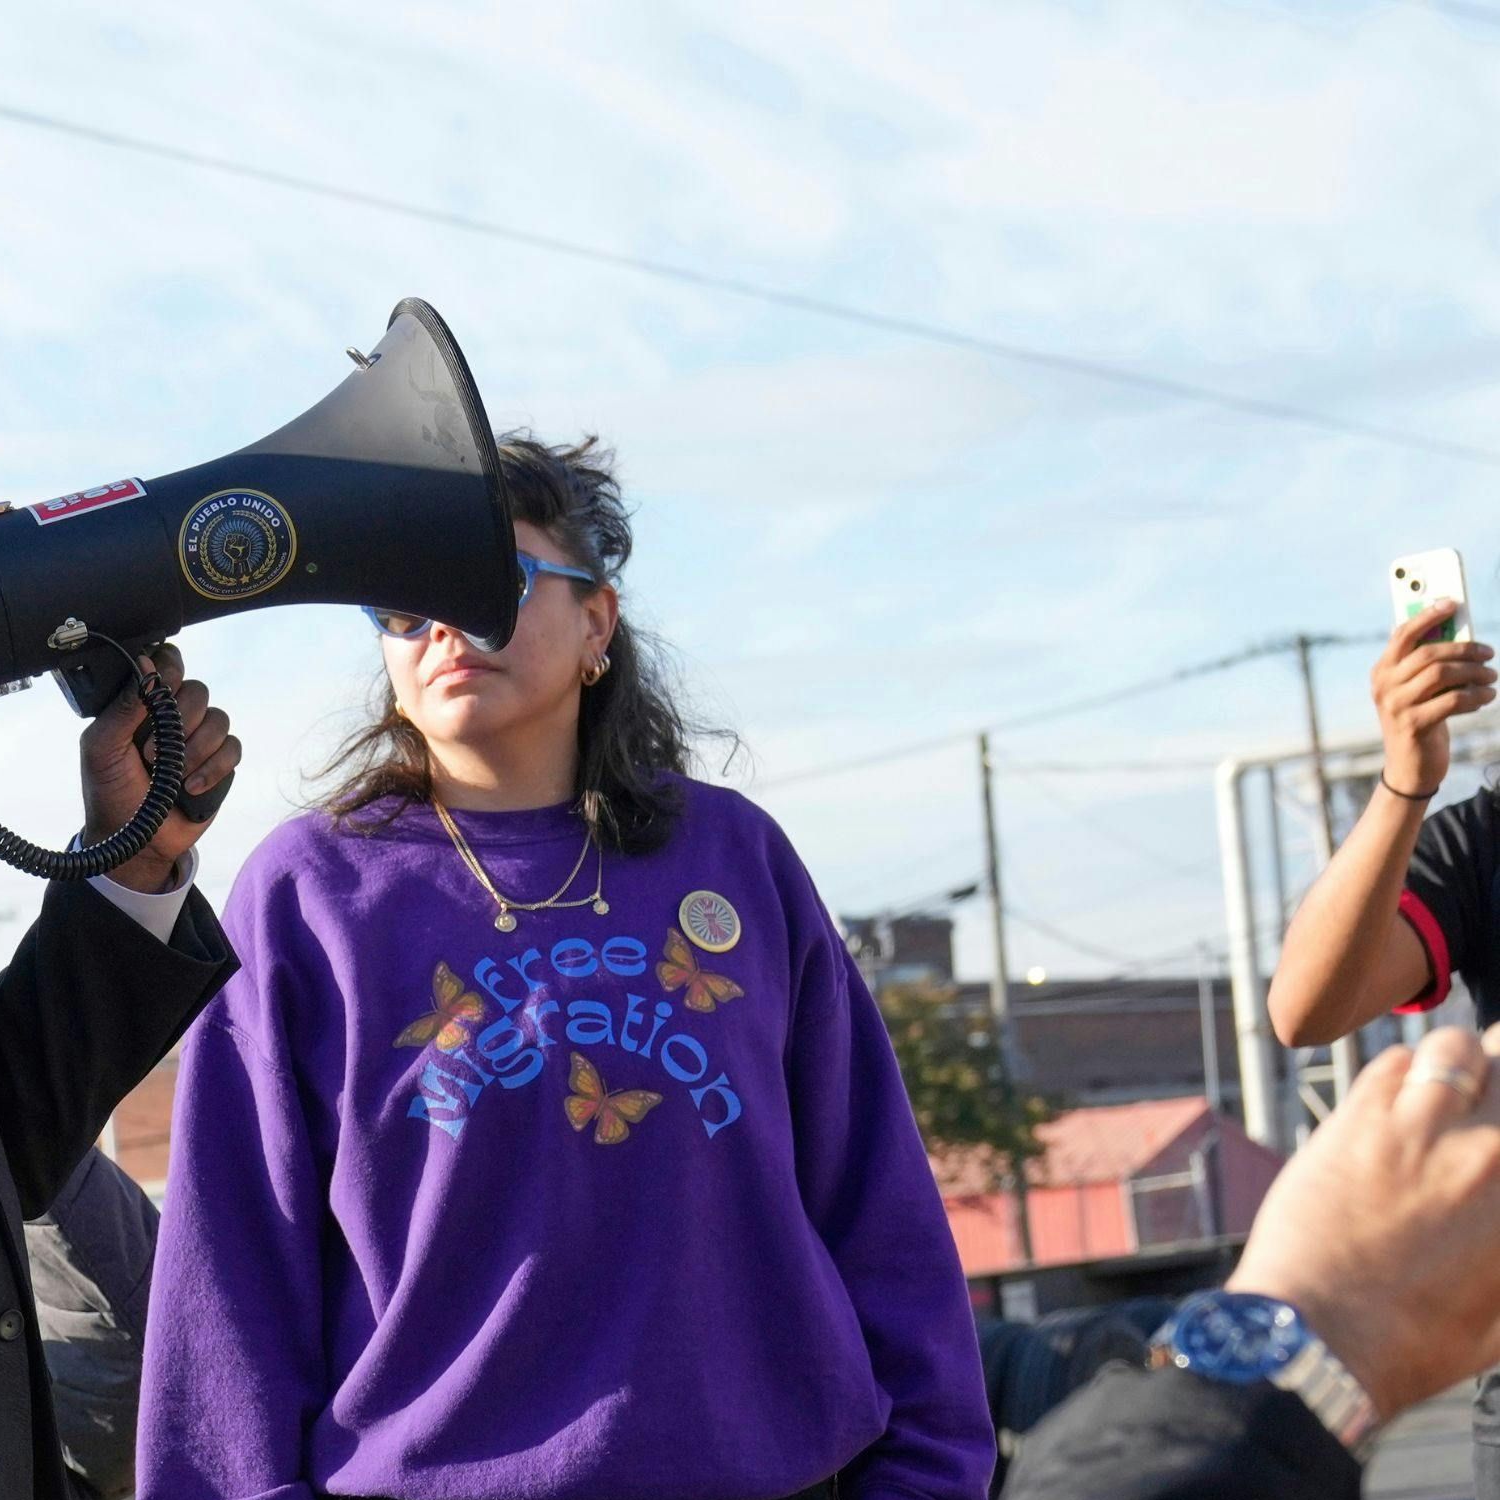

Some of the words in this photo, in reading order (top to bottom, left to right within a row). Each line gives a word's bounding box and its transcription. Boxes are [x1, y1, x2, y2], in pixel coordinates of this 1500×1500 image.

[192, 497, 237, 532] PUEBLO
[242, 497, 281, 528] UNIDO
[188, 535, 198, 553] EL
[197, 576, 221, 594] ATLANTIC
[221, 587, 234, 595] CITY
[473, 935, 647, 1014] free
